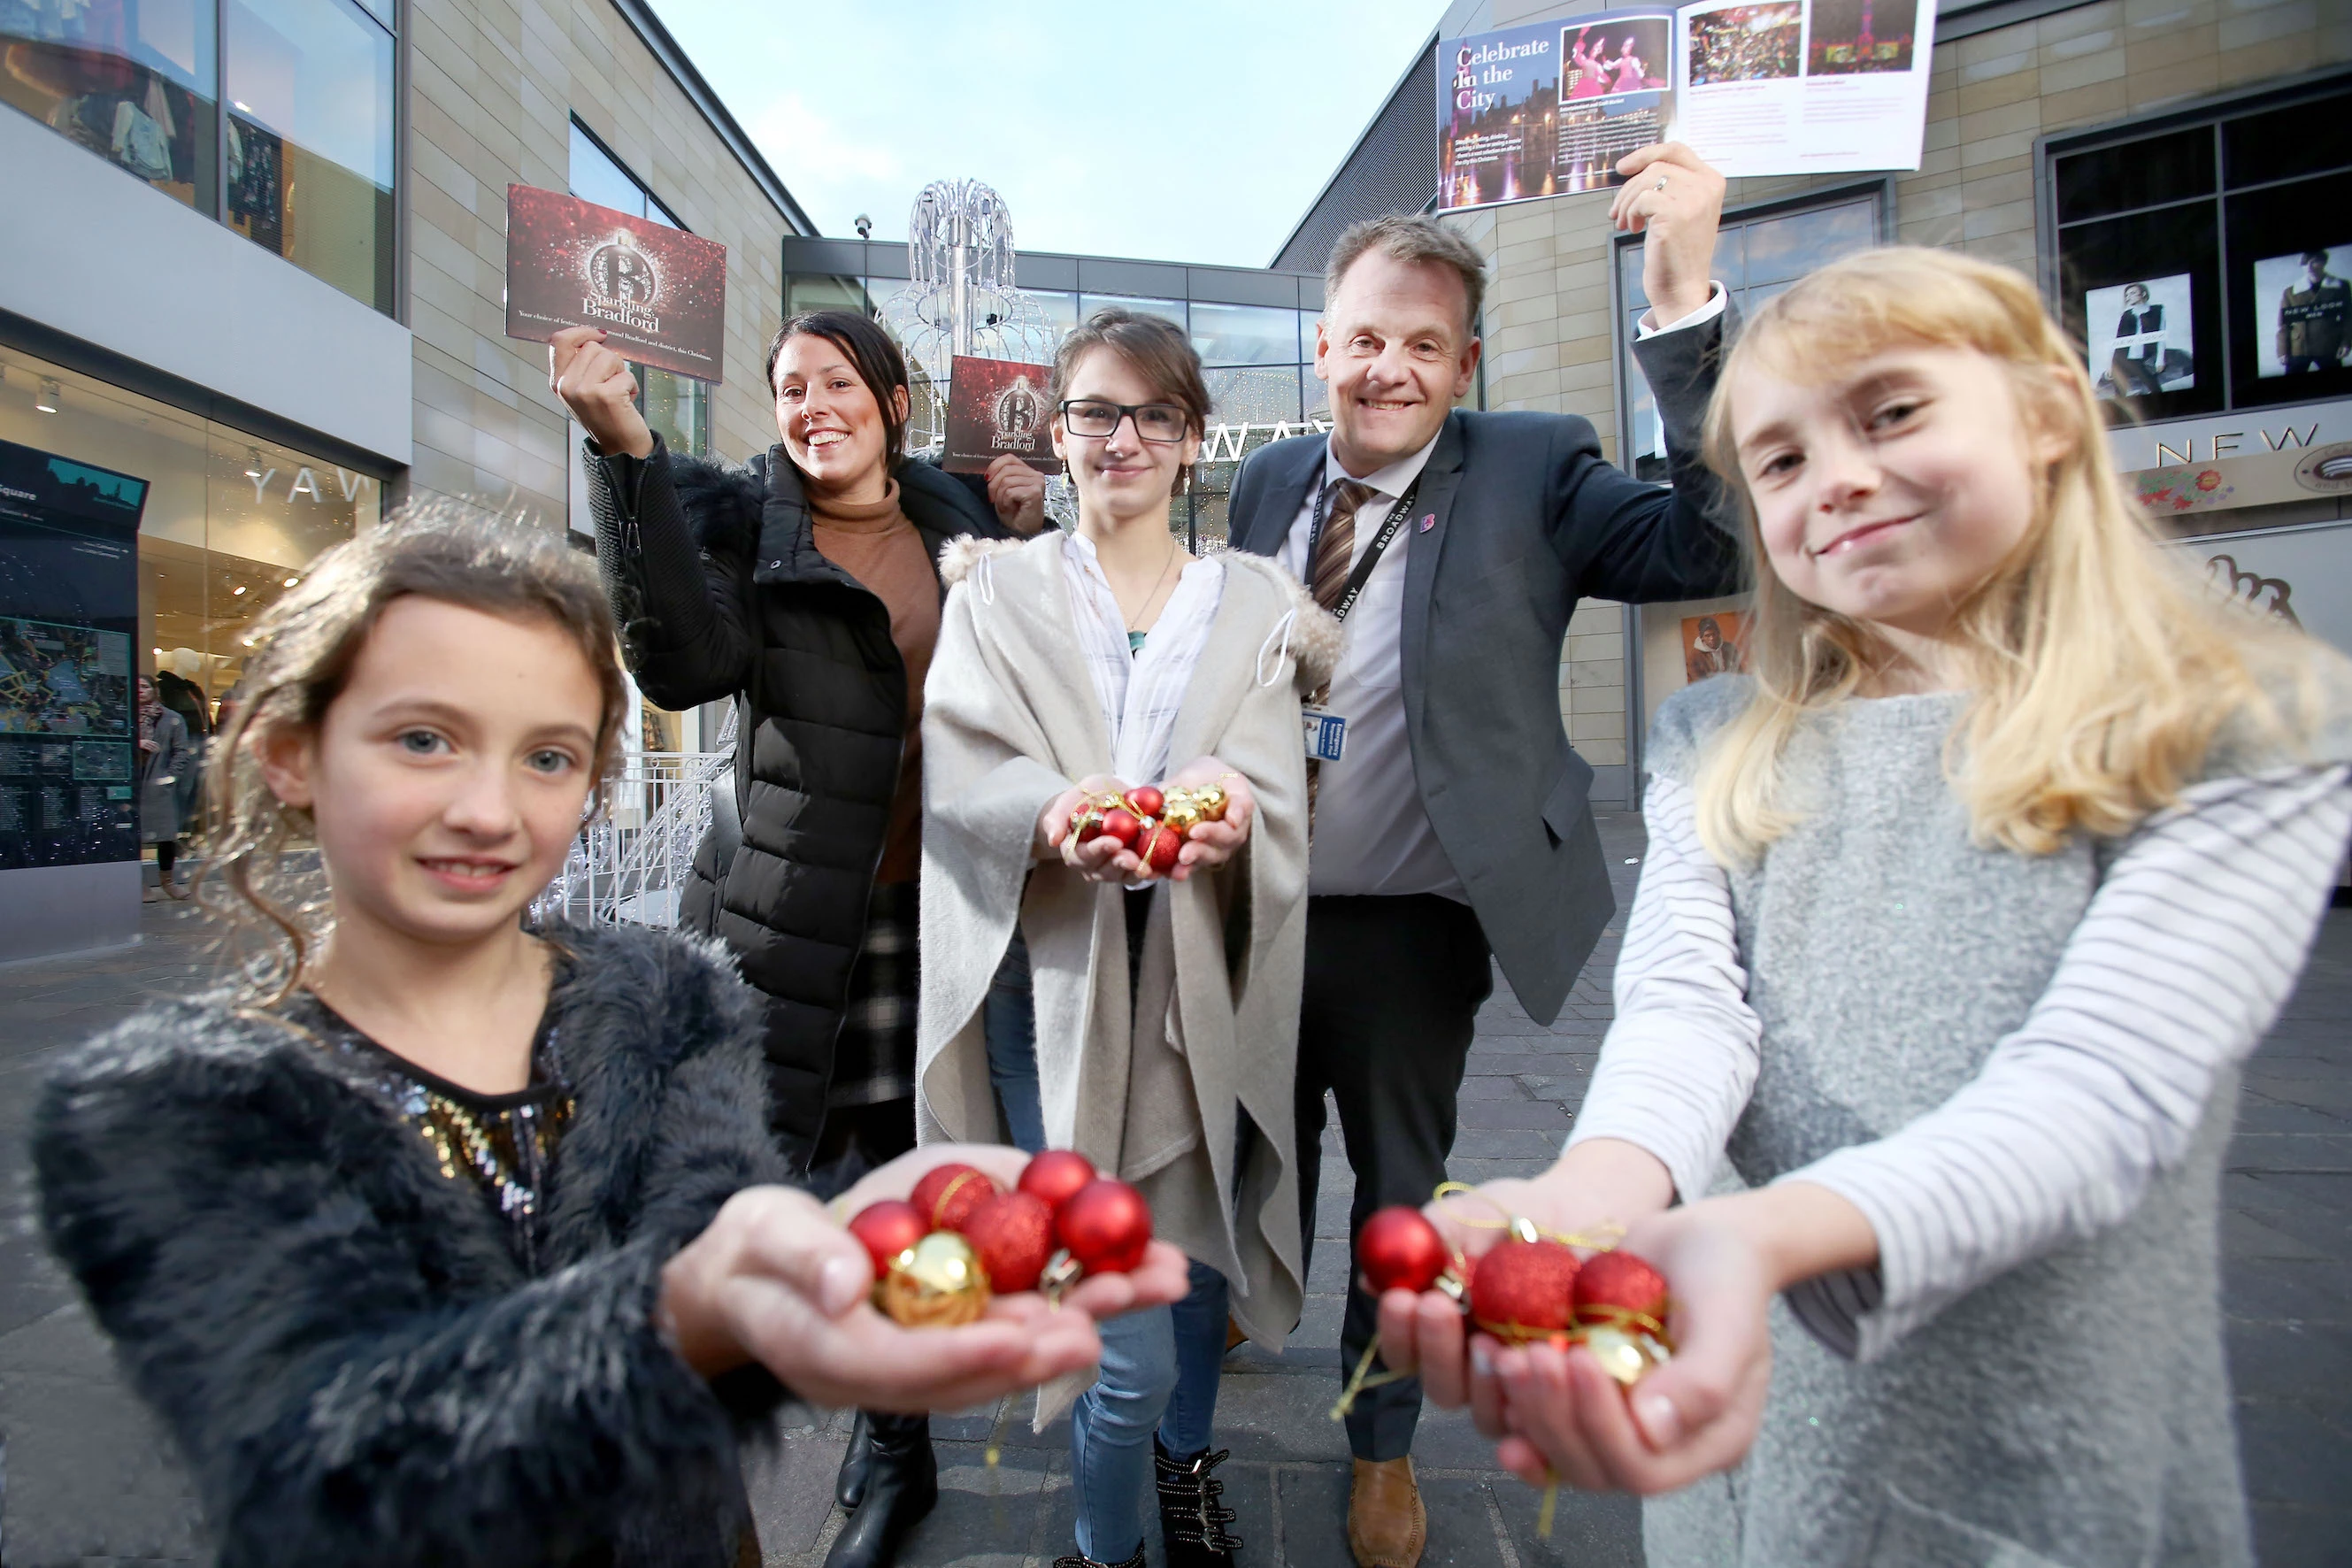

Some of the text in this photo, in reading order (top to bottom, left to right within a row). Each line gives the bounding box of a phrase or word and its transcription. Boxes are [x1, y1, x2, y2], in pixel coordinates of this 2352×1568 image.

[1457, 40, 1549, 67] Celebrate
[1457, 65, 1513, 89] In the
[1457, 90, 1496, 111] City
[581, 297, 660, 333] Bradford
[589, 288, 652, 319] Sparkling
[519, 310, 533, 319] Your
[534, 313, 553, 323] choice
[625, 333, 648, 345] Bradford
[648, 339, 658, 348] and
[991, 435, 1035, 450] Bradford
[996, 427, 1033, 441] Sparkling
[1376, 494, 1416, 550] BROADWAY
[1336, 587, 1359, 622] DWAY
